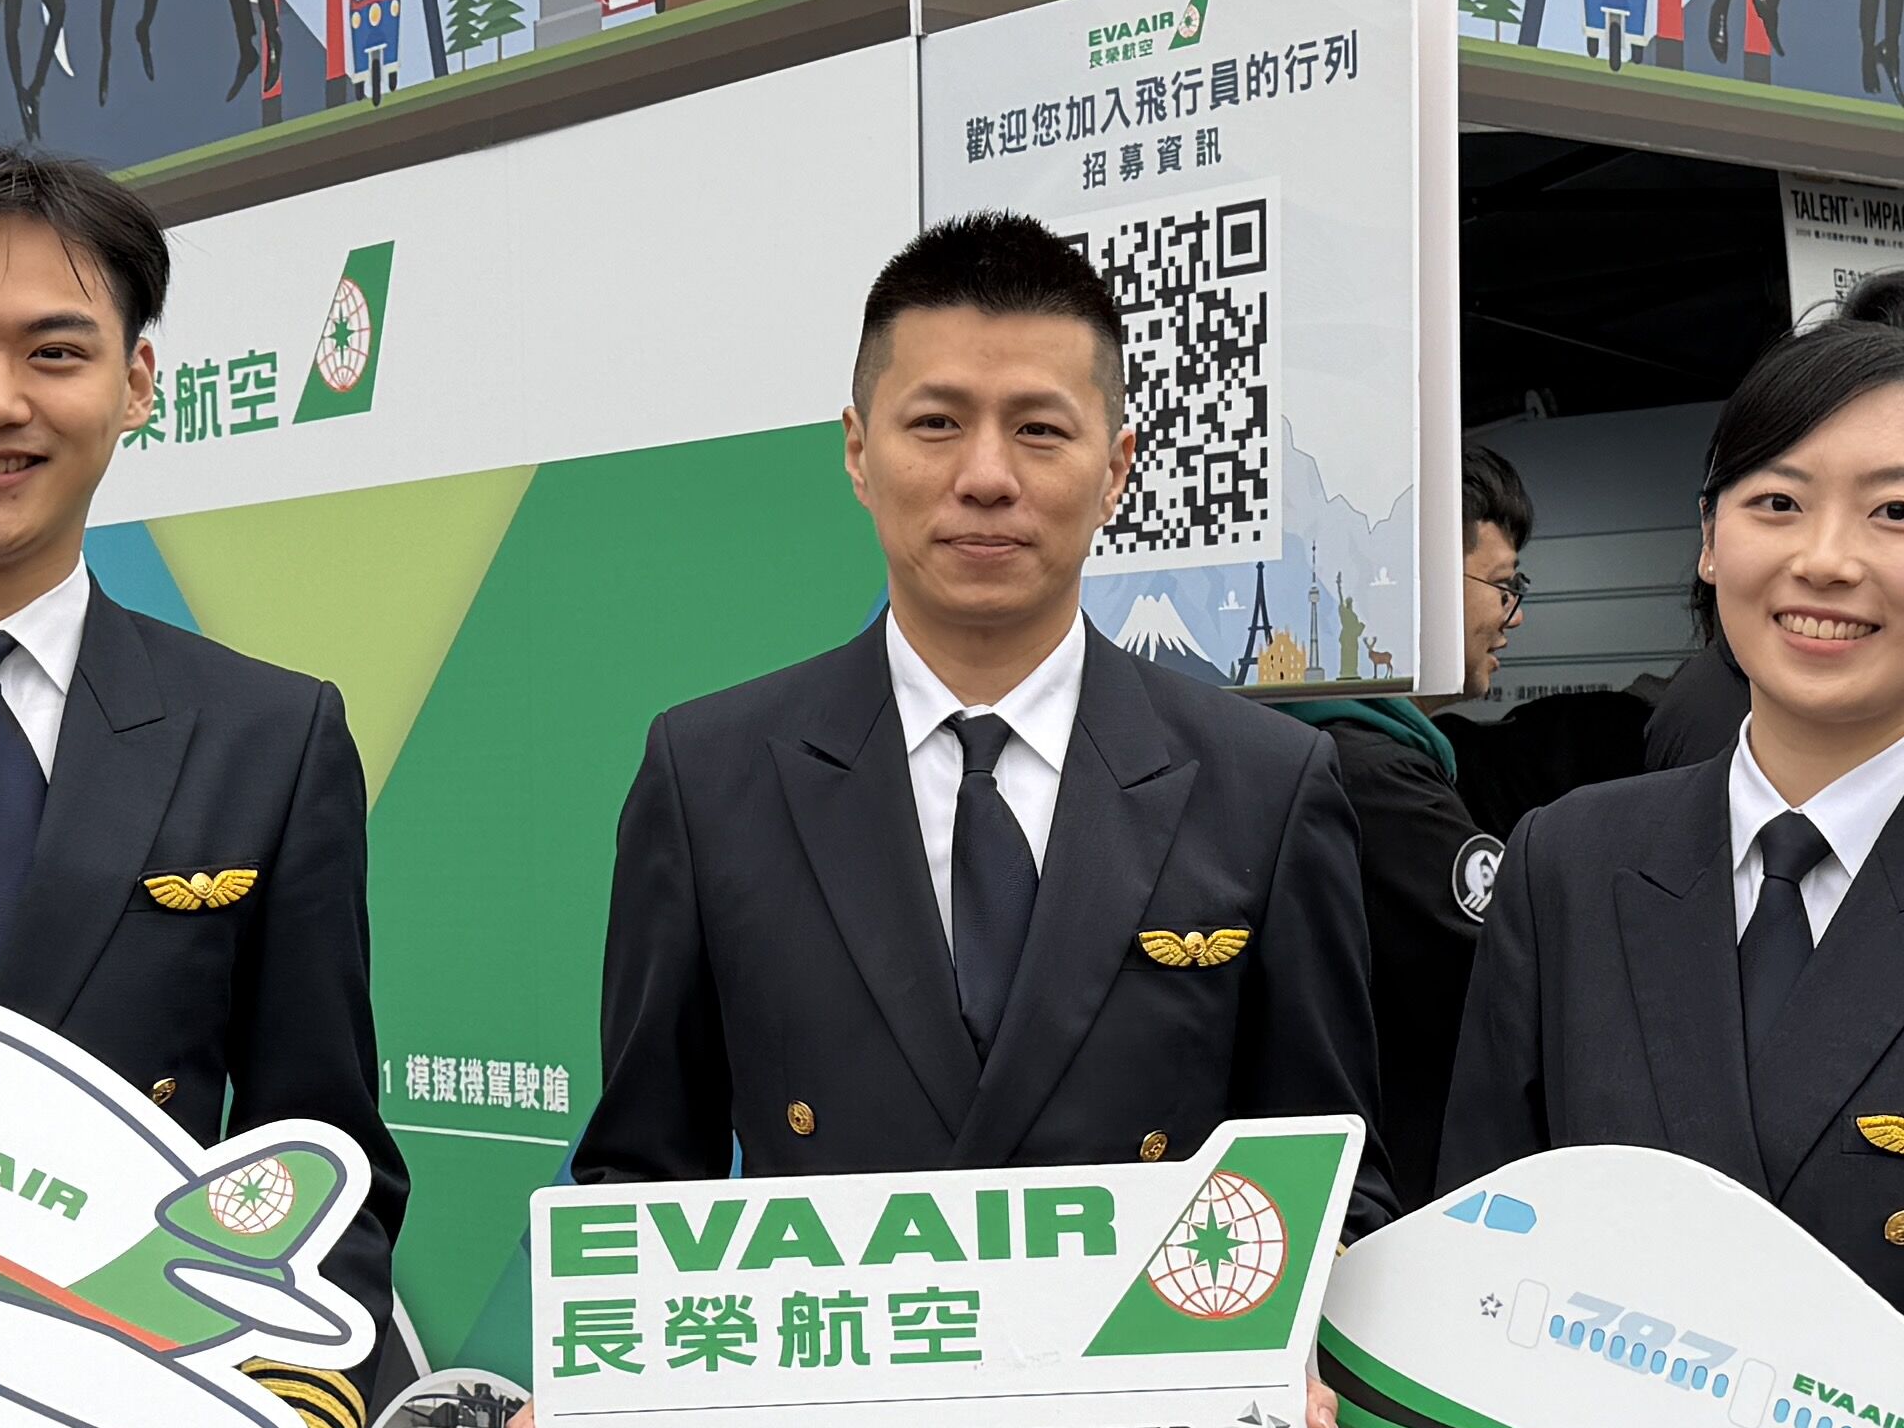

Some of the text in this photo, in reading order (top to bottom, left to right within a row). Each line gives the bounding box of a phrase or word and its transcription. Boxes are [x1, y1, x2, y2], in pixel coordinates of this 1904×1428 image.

[1088, 38, 1154, 70] 長榮航空
[965, 28, 1359, 165] 歡迎您加入飛行員的行列
[1081, 126, 1223, 191] 招募資訊
[1790, 189, 1849, 226] TALENT
[405, 1053, 570, 1114] 模擬機駕駛艙
[551, 1287, 982, 1379] 長榮航空
[1552, 1290, 1738, 1392] 787
